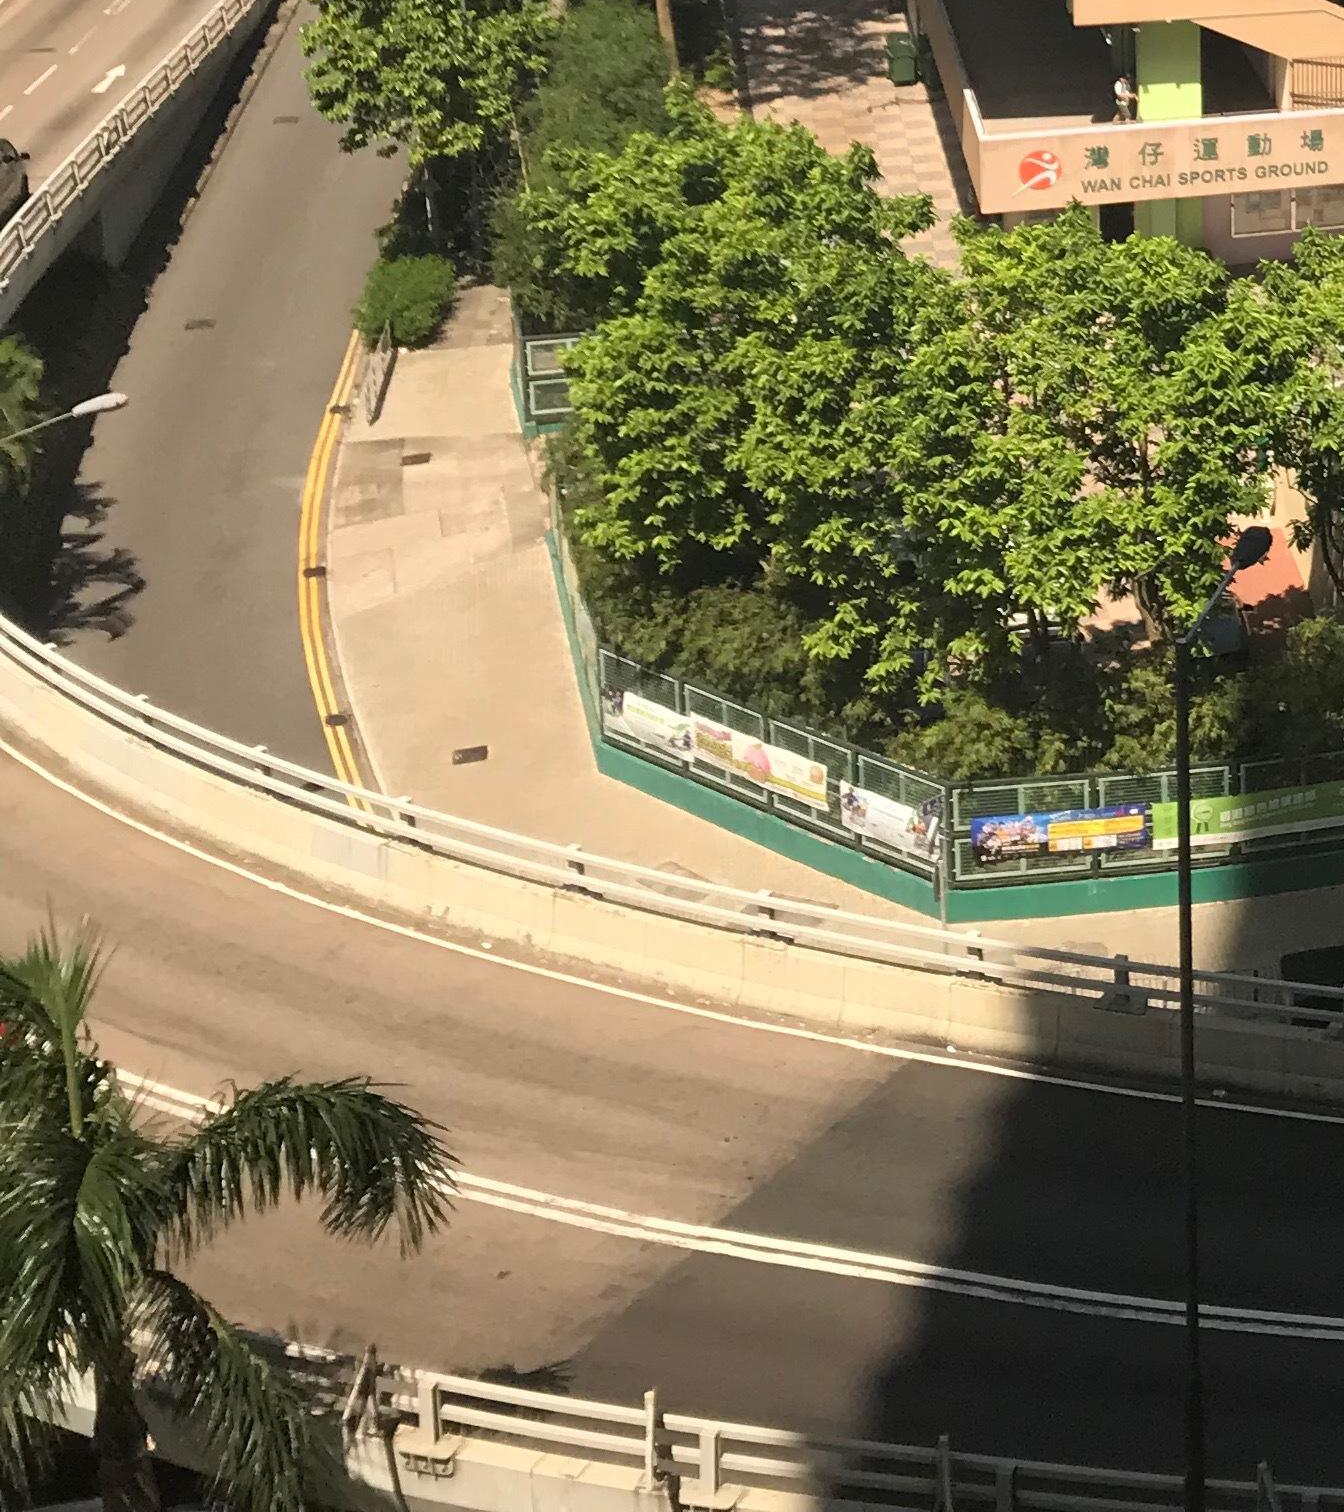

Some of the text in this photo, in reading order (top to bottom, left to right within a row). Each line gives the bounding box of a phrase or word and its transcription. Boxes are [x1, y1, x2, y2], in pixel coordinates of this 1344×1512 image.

[1084, 129, 1325, 170] 灣仔運動場
[1081, 160, 1329, 193] WAN CHAI SPORTS GROUND
